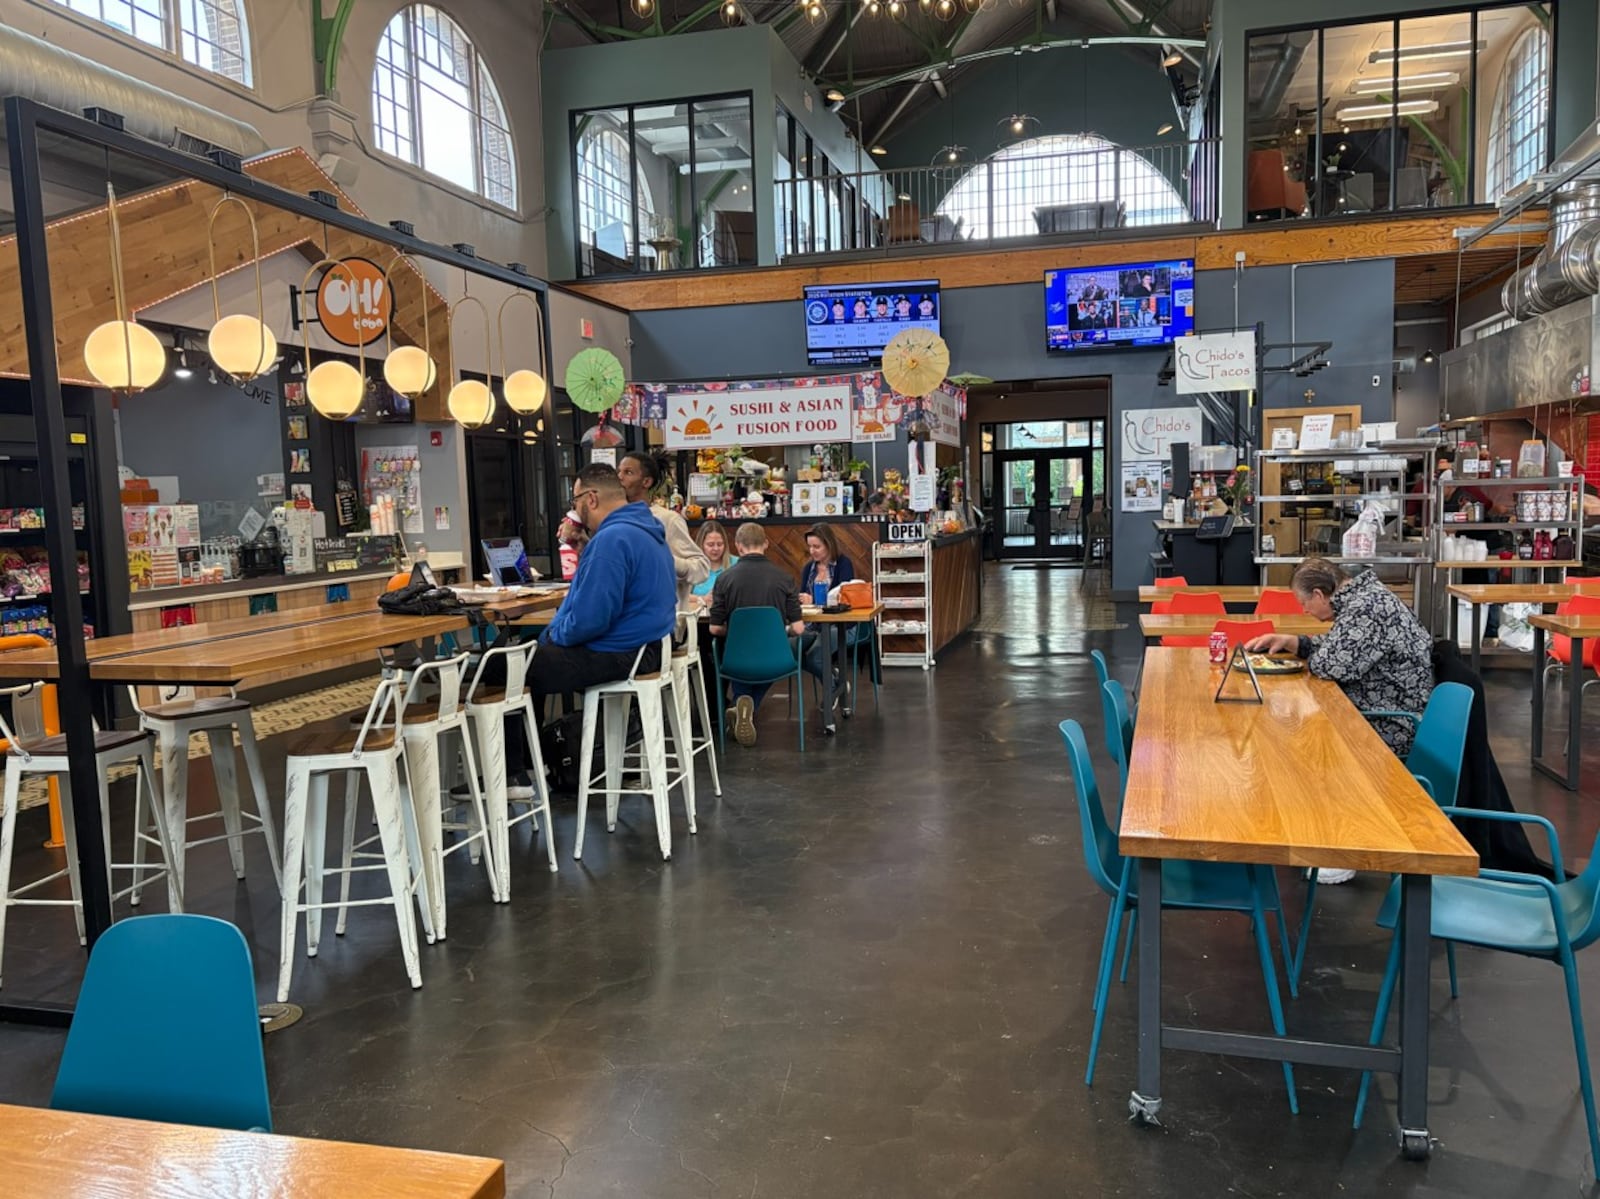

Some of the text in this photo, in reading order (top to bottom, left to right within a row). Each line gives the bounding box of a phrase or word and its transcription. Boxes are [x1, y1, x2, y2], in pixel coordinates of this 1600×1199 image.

[324, 278, 384, 316] OH!
[1195, 348, 1245, 365] Chido's
[1206, 364, 1250, 381] Tacos
[729, 398, 844, 417] SUSHI & ASIAN
[737, 419, 838, 436] FUSION FOOD
[1141, 416, 1192, 436] Chido's
[891, 525, 922, 539] OPEN
